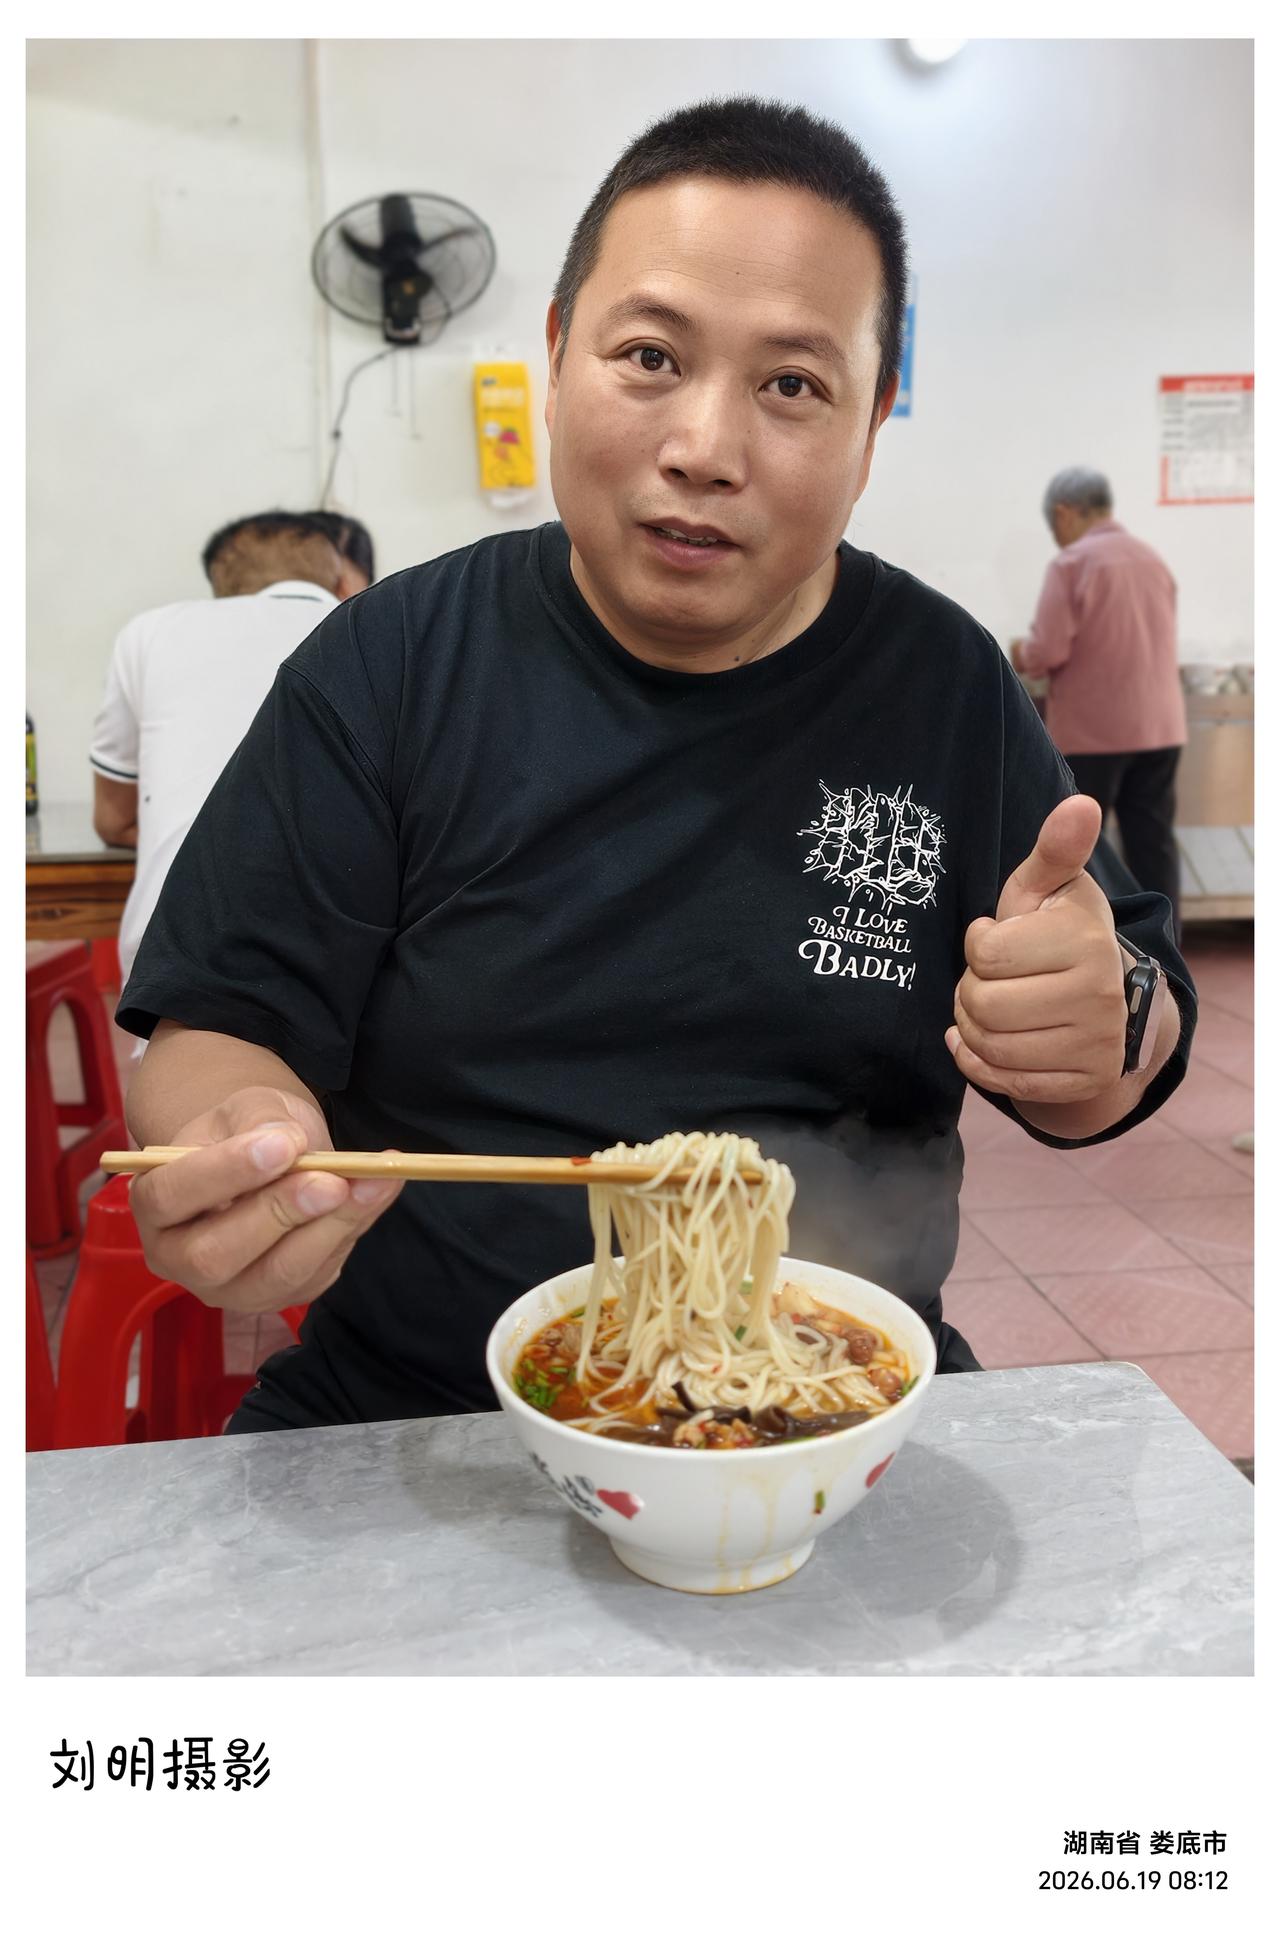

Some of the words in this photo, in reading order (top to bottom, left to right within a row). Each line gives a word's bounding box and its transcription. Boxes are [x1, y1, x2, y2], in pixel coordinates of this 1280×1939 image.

[808, 916, 911, 953] BASKETBALL
[833, 906, 850, 925] I
[855, 908, 908, 934] LOVE
[798, 939, 916, 991] BADLY!
